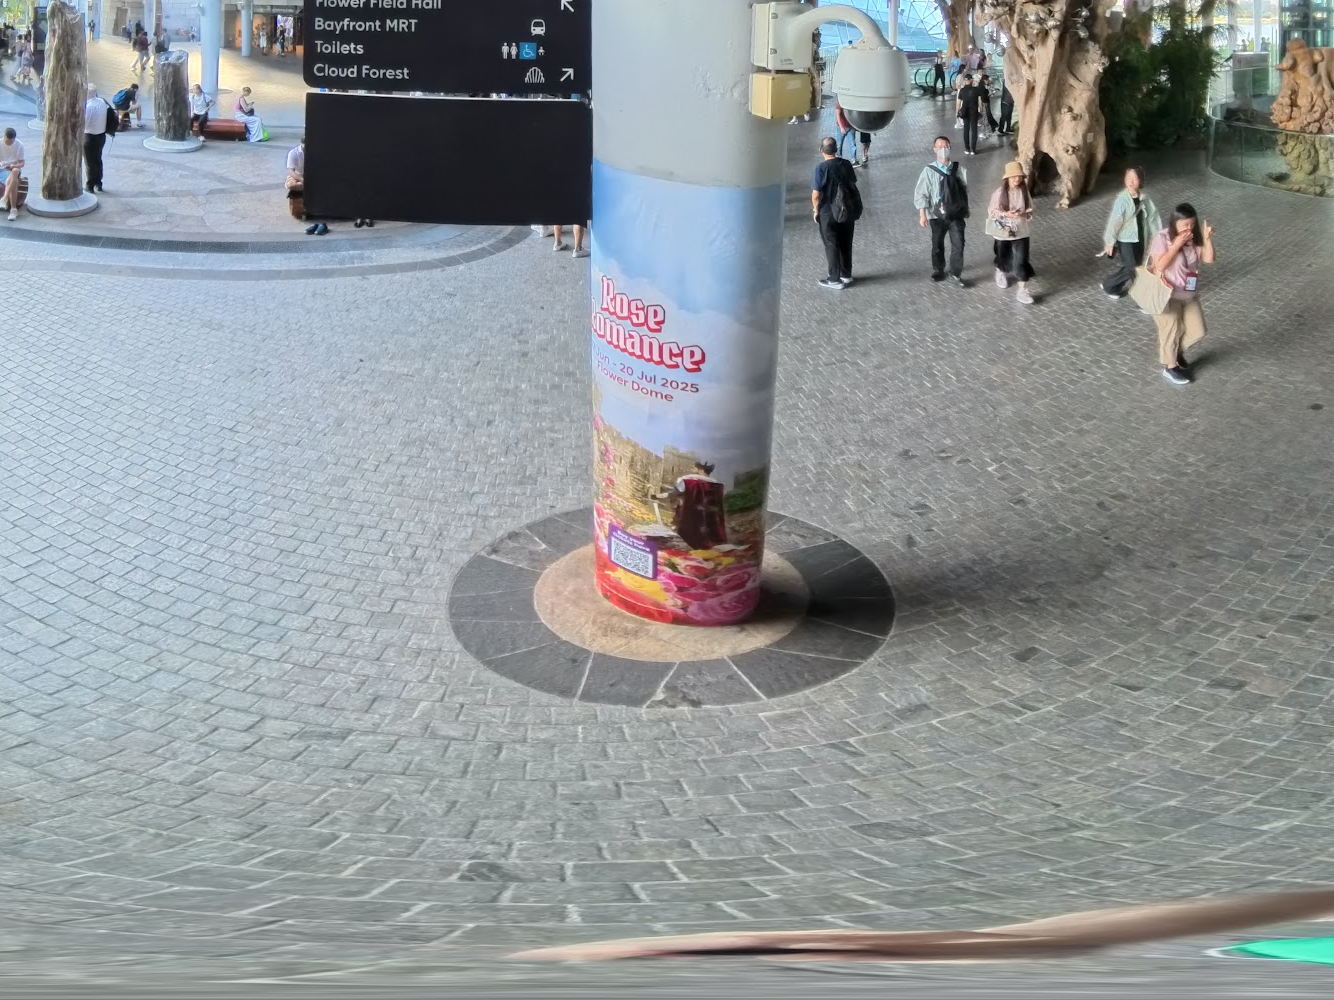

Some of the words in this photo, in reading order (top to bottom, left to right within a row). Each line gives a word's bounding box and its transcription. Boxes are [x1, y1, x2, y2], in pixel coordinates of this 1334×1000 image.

[314, 18, 381, 34] Bayfront
[386, 19, 418, 32] MRT
[315, 40, 364, 55] Toilets
[313, 63, 358, 78] Cloud
[361, 65, 409, 80] Forest
[601, 275, 665, 333] Rose
[596, 348, 610, 364] Jun
[619, 362, 634, 376] 20
[637, 370, 656, 385] Jul
[660, 378, 699, 393] 2025
[597, 361, 628, 387] Flower
[631, 380, 674, 402] Dome
